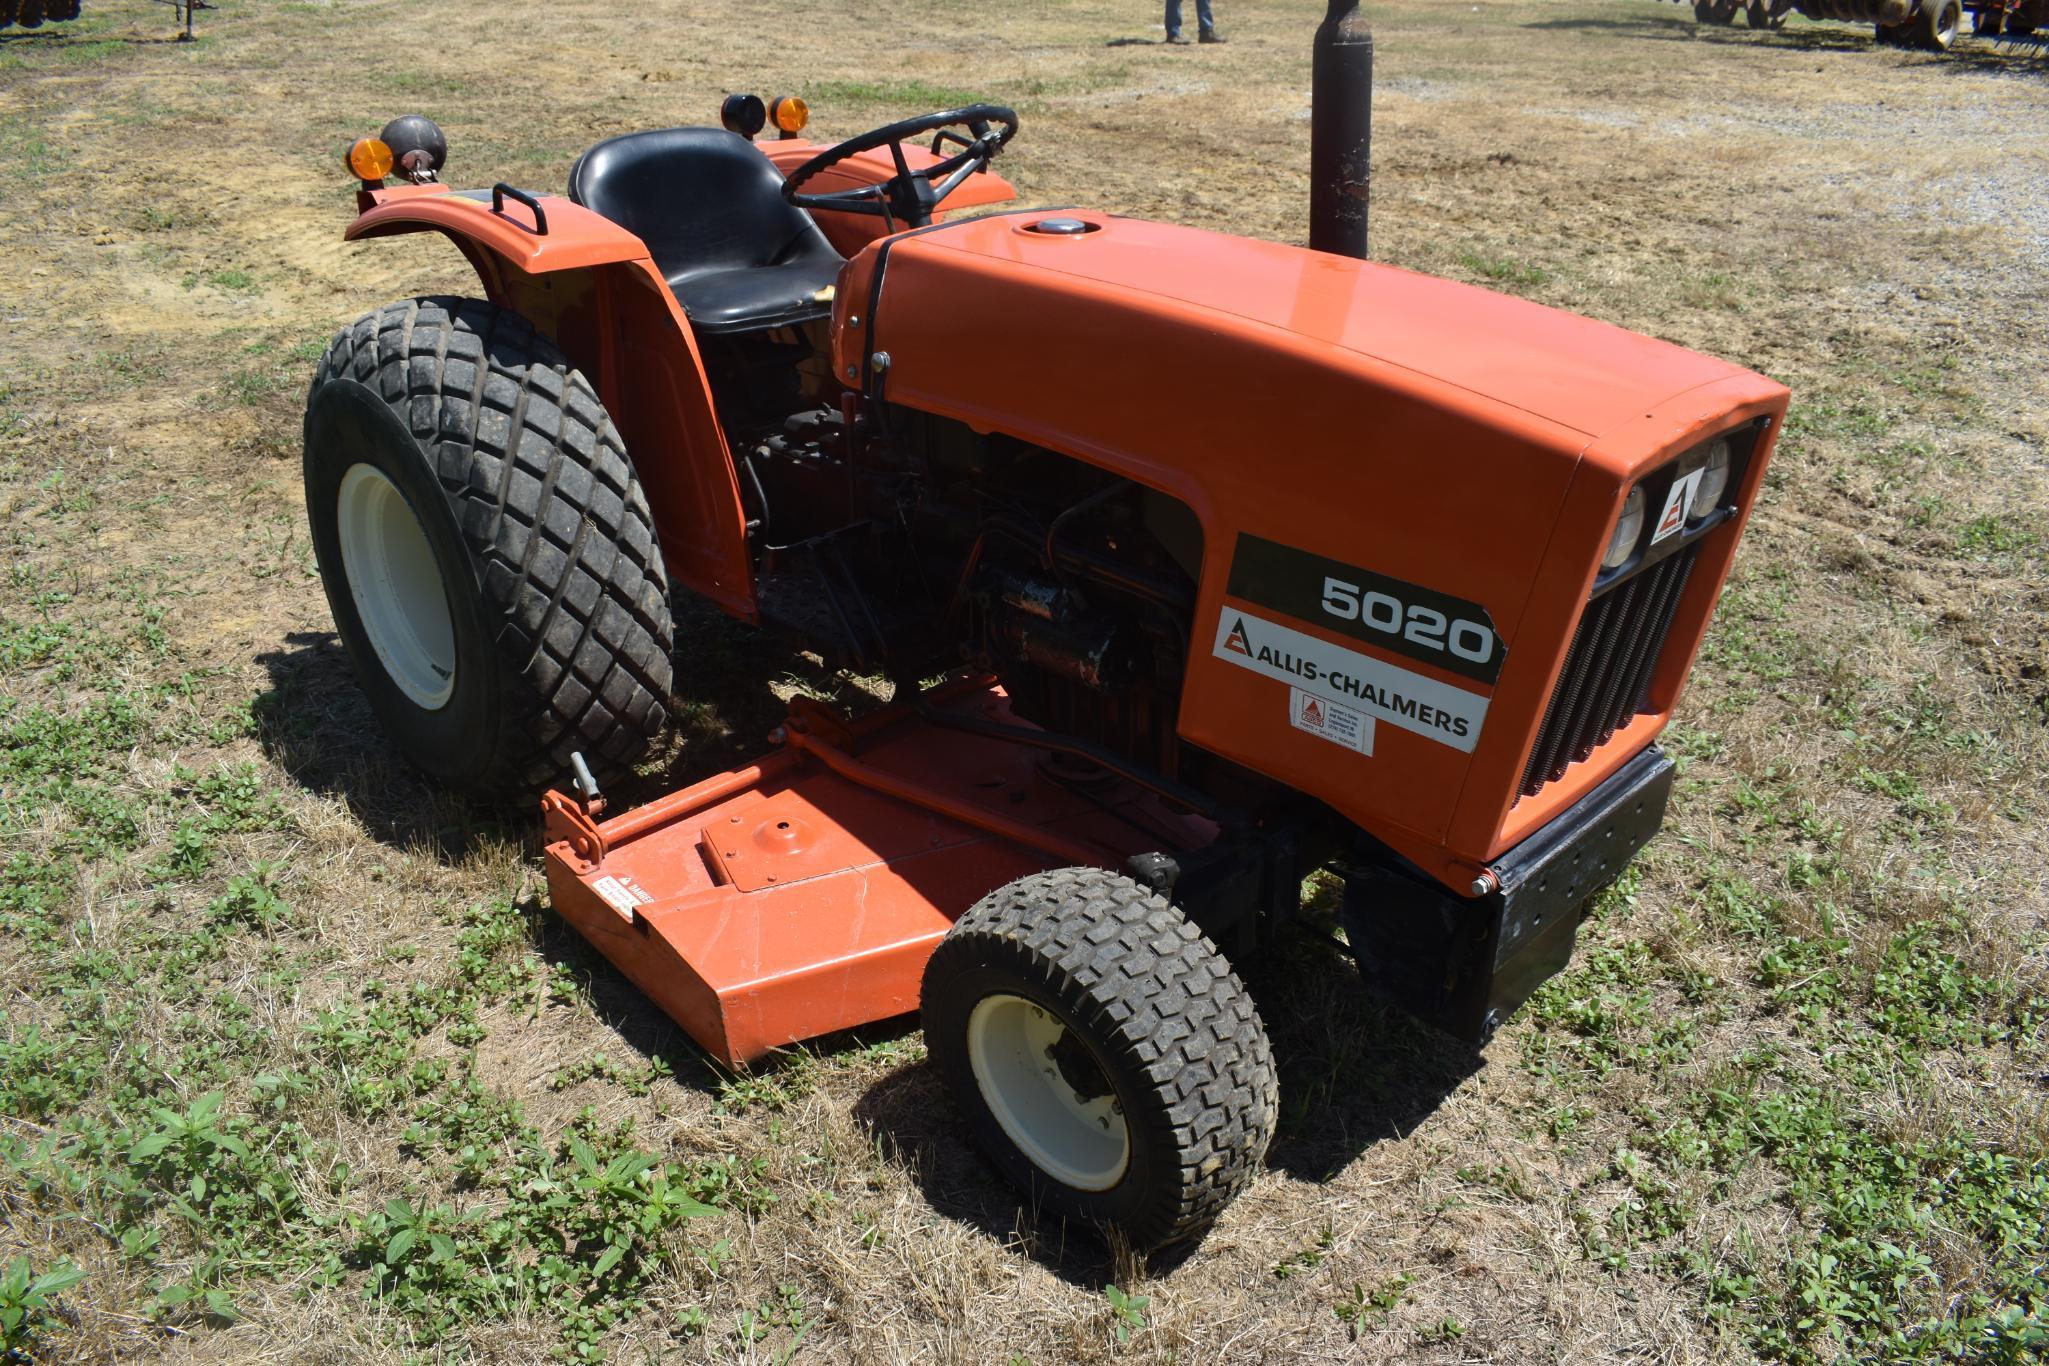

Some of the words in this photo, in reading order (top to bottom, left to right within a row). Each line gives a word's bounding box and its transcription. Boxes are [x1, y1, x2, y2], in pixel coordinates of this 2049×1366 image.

[1321, 576, 1494, 664] 5020
[1257, 645, 1469, 737] ALLIS-CHALMERS
[629, 884, 655, 904] DANGER
